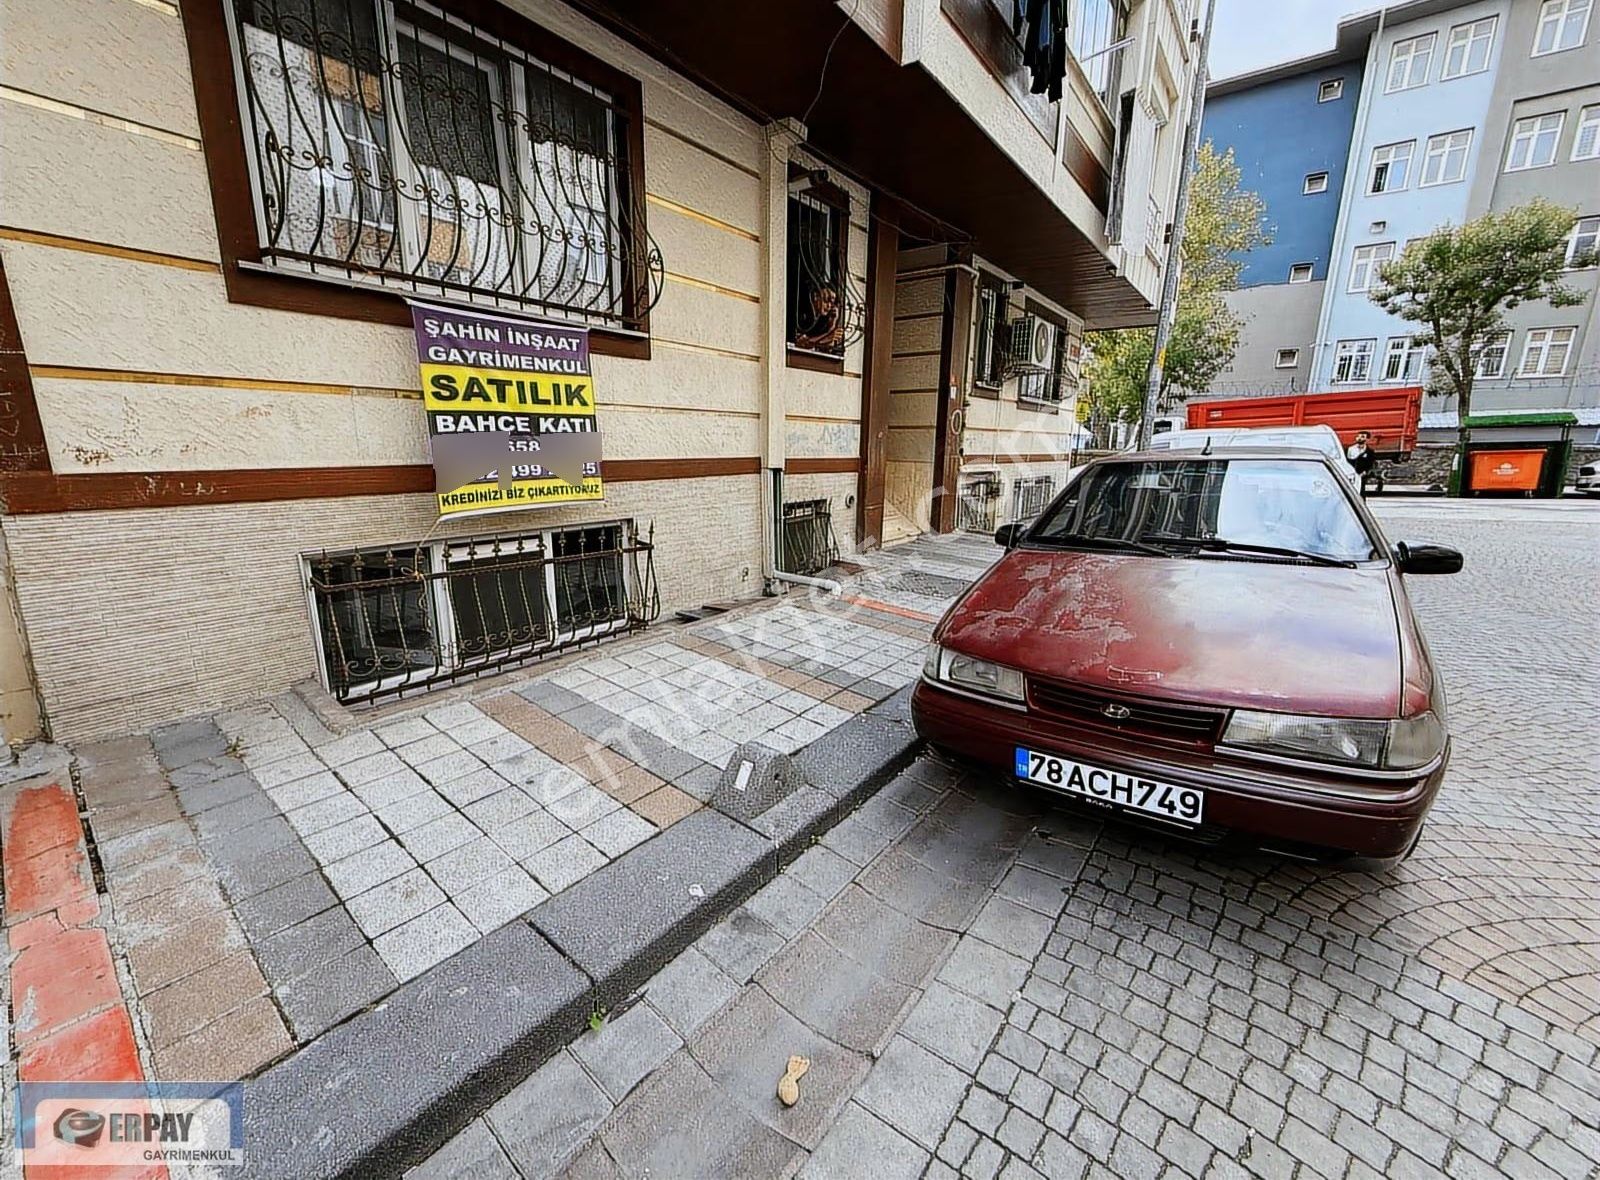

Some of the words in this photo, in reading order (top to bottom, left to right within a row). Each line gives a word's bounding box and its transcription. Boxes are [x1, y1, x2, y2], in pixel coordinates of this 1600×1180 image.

[424, 318, 500, 343] ŞAHİN
[507, 326, 580, 352] İNŞAAT
[428, 346, 587, 374] GAYRİMENKUL
[430, 374, 589, 407] SATILIK
[539, 417, 592, 433] KATI
[506, 487, 525, 500] BİZ
[1030, 754, 1200, 819] 78ACH749
